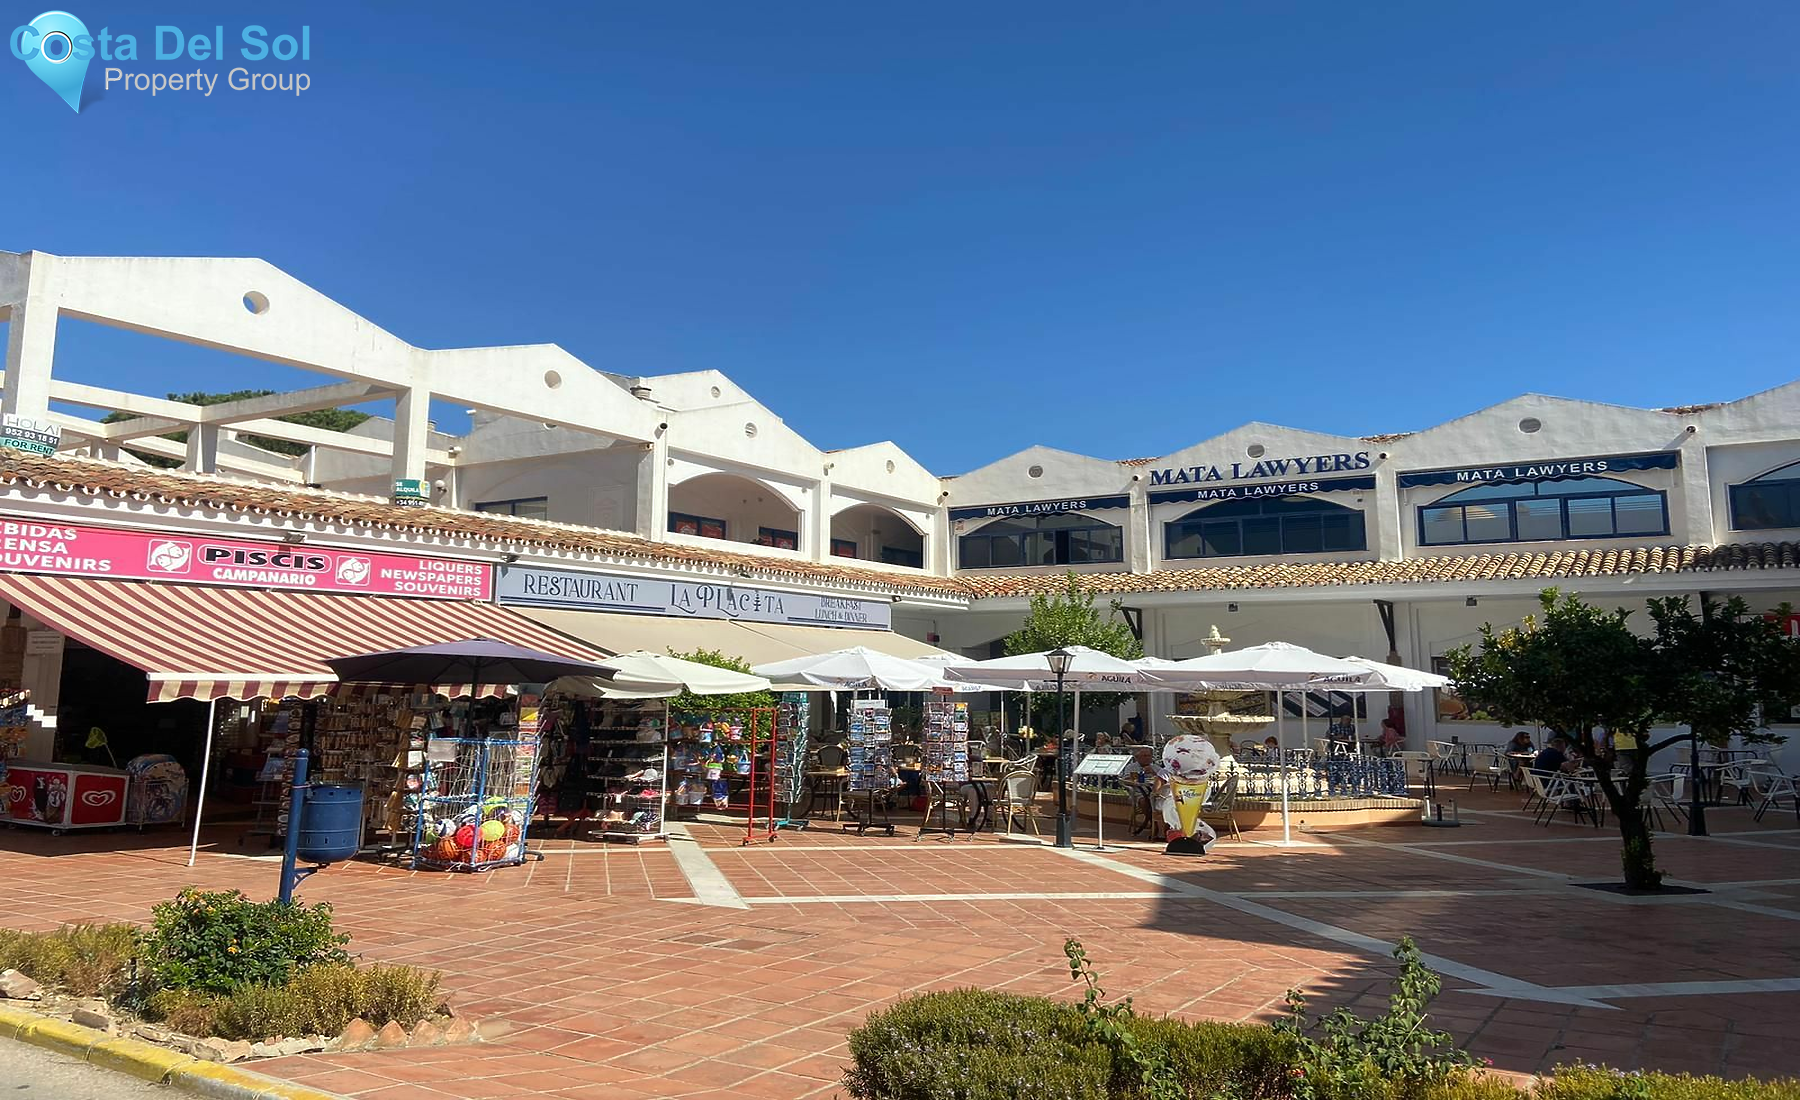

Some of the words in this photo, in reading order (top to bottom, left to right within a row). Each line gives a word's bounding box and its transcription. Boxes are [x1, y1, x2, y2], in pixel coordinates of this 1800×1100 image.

[4, 439, 28, 449] FOR
[30, 443, 54, 455] RENT
[1150, 465, 1223, 485] MATA
[1231, 451, 1370, 480] LAWYERS
[1457, 469, 1505, 481] MATA
[1515, 460, 1608, 477] LAWYERS
[1197, 488, 1237, 499] MATA
[1244, 482, 1319, 496] LAWYERS
[987, 506, 1019, 516] MATA
[1026, 500, 1087, 513] LAWYERS
[0, 522, 78, 540] BIDAS
[0, 537, 69, 554] ENSA
[205, 547, 326, 570] PISCIS
[213, 567, 316, 586] CAMPANARIO
[381, 568, 482, 586] NEWSPAPERS
[419, 560, 482, 576] LIQUERS
[395, 581, 481, 597] SOUVENIRS
[524, 573, 638, 602] RESTAURANT
[671, 584, 696, 614] LA
